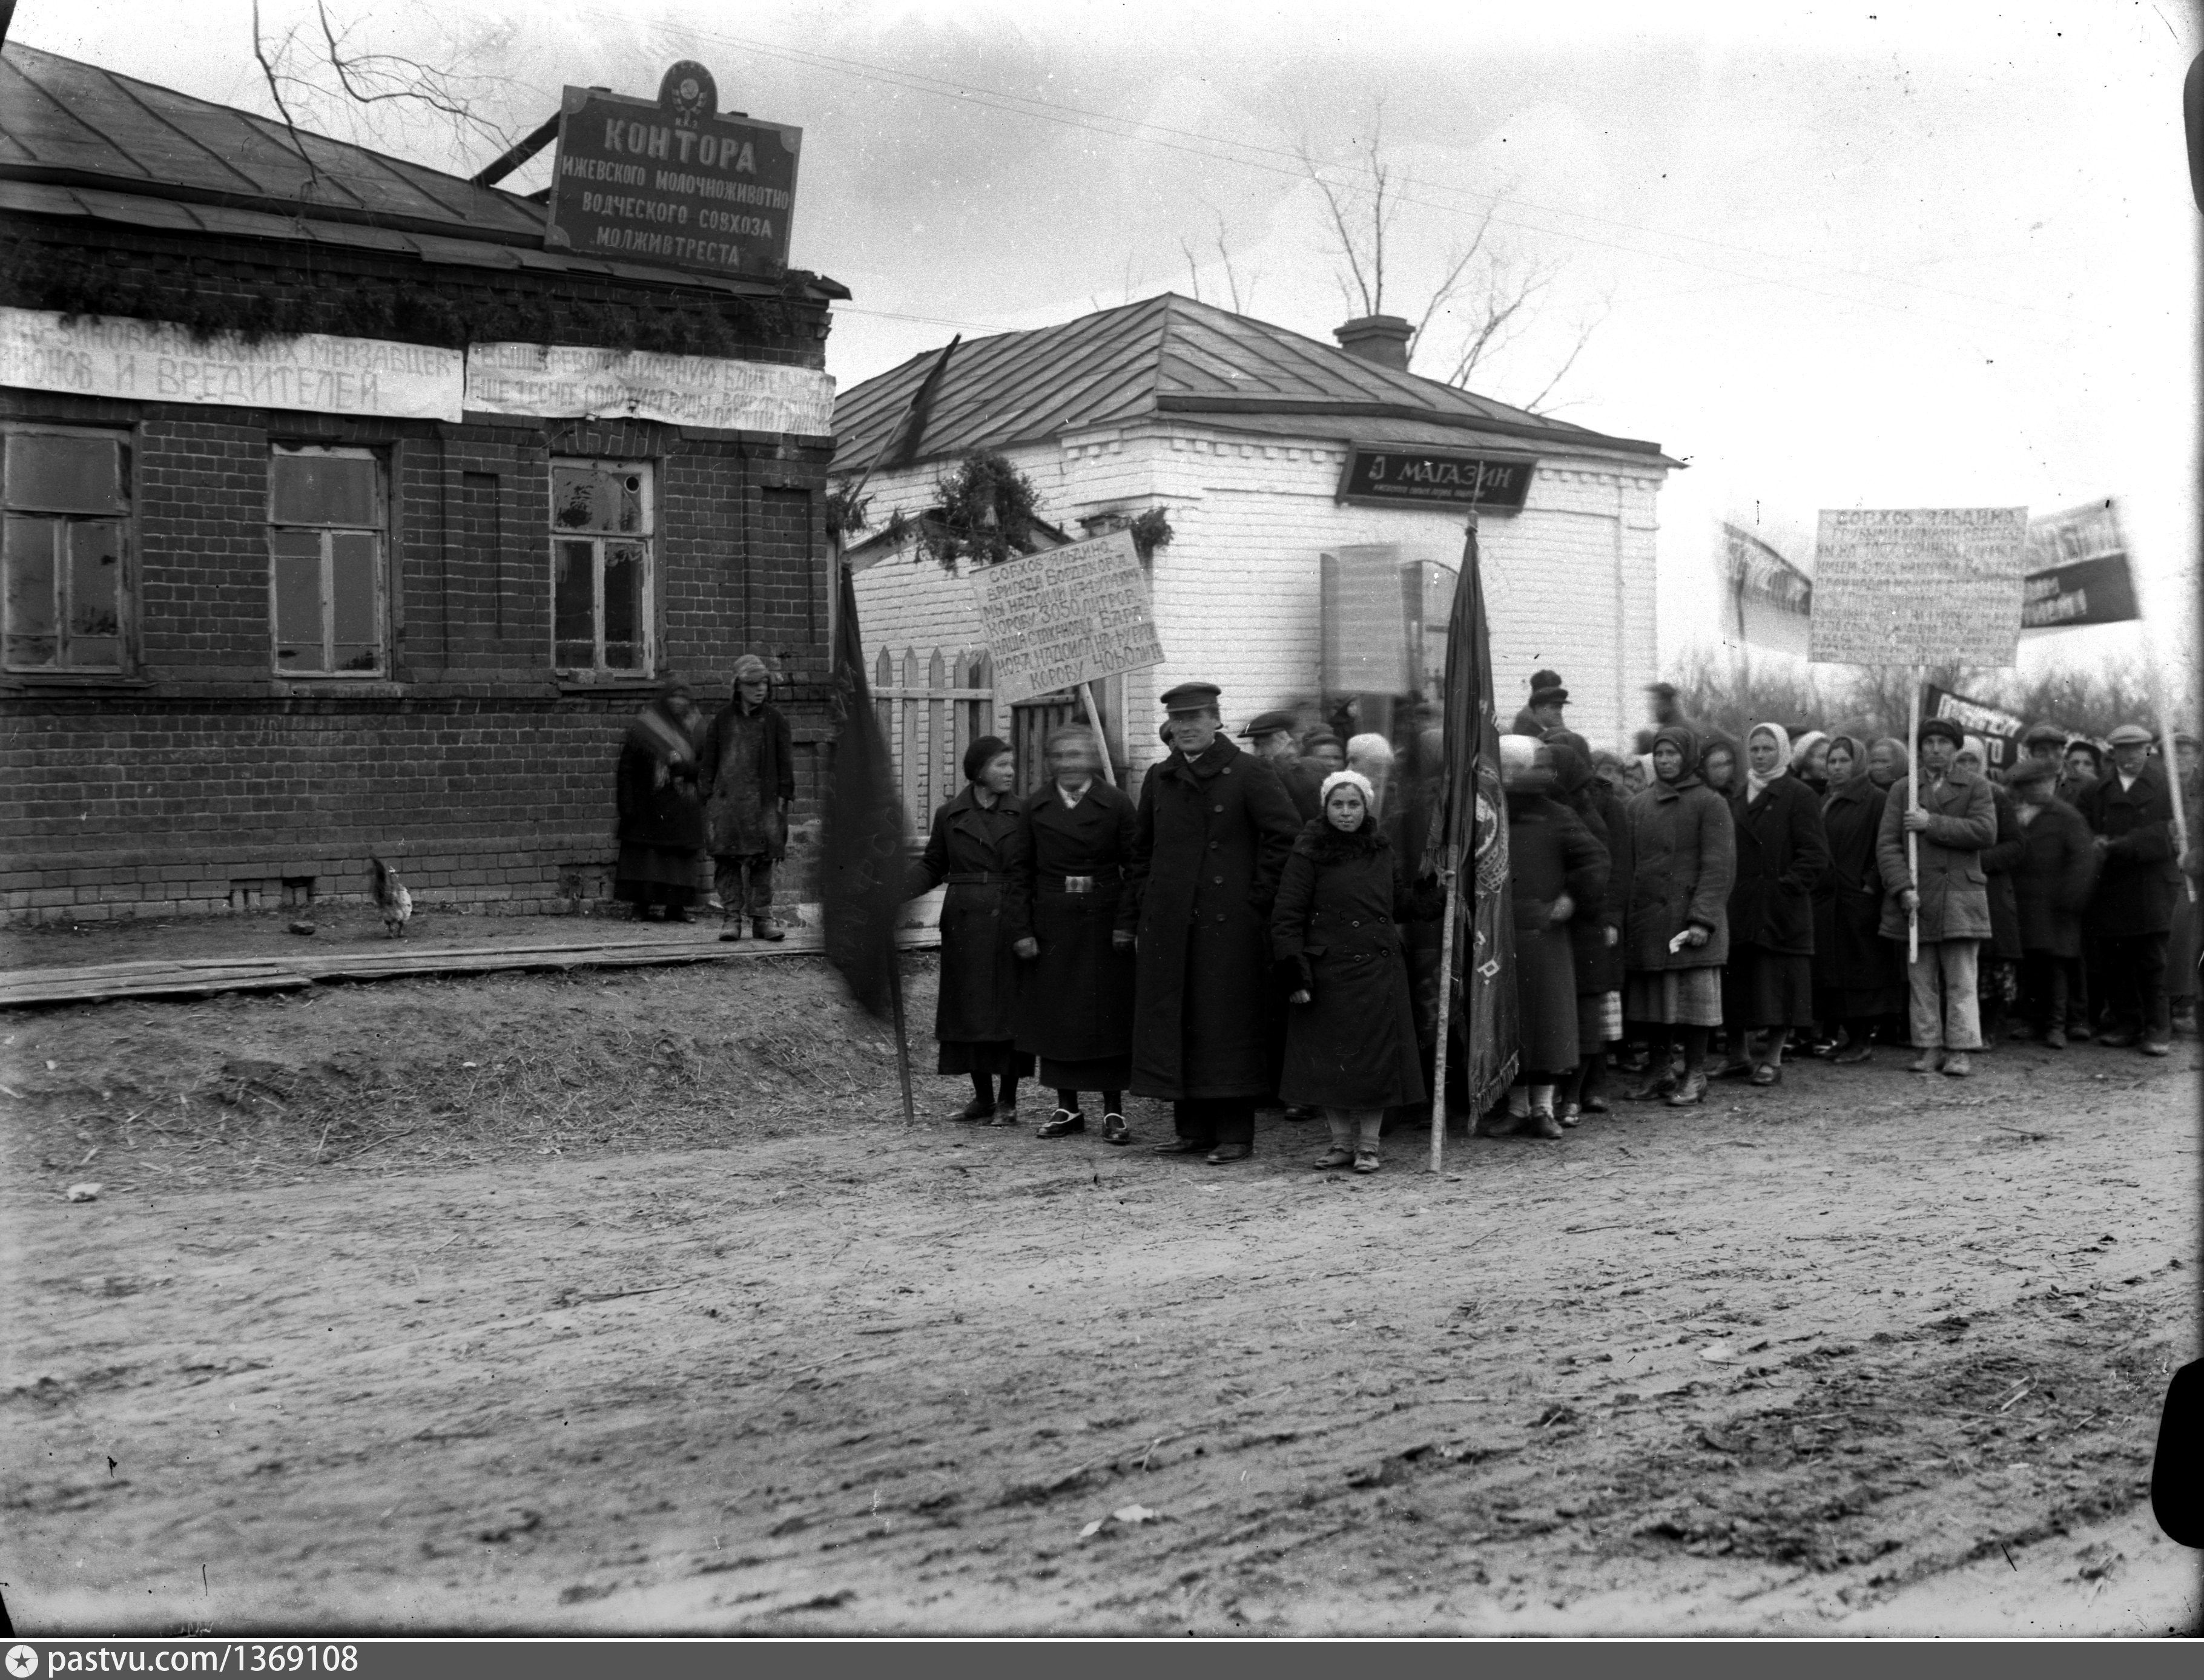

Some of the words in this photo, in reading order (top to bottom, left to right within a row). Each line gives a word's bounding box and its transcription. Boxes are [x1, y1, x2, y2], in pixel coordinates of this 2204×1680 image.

[604, 118, 757, 174] КОНТОРА
[561, 155, 647, 186] ИЖЕВСКОГО
[582, 191, 688, 225] ВОДЧЕСКОГО
[699, 209, 773, 239] СОВХОЗА
[114, 355, 136, 391] И
[157, 357, 379, 410] ВРЕДИТЕЛЕЙ
[1397, 461, 1513, 488] МАГАЗИН
[987, 575, 1043, 602] БРИГАДА
[983, 603, 1005, 621] МЫ
[988, 612, 1037, 638] КОРОВУ
[1039, 598, 1080, 624] 3050
[1030, 660, 1086, 692] КОРОВУ
